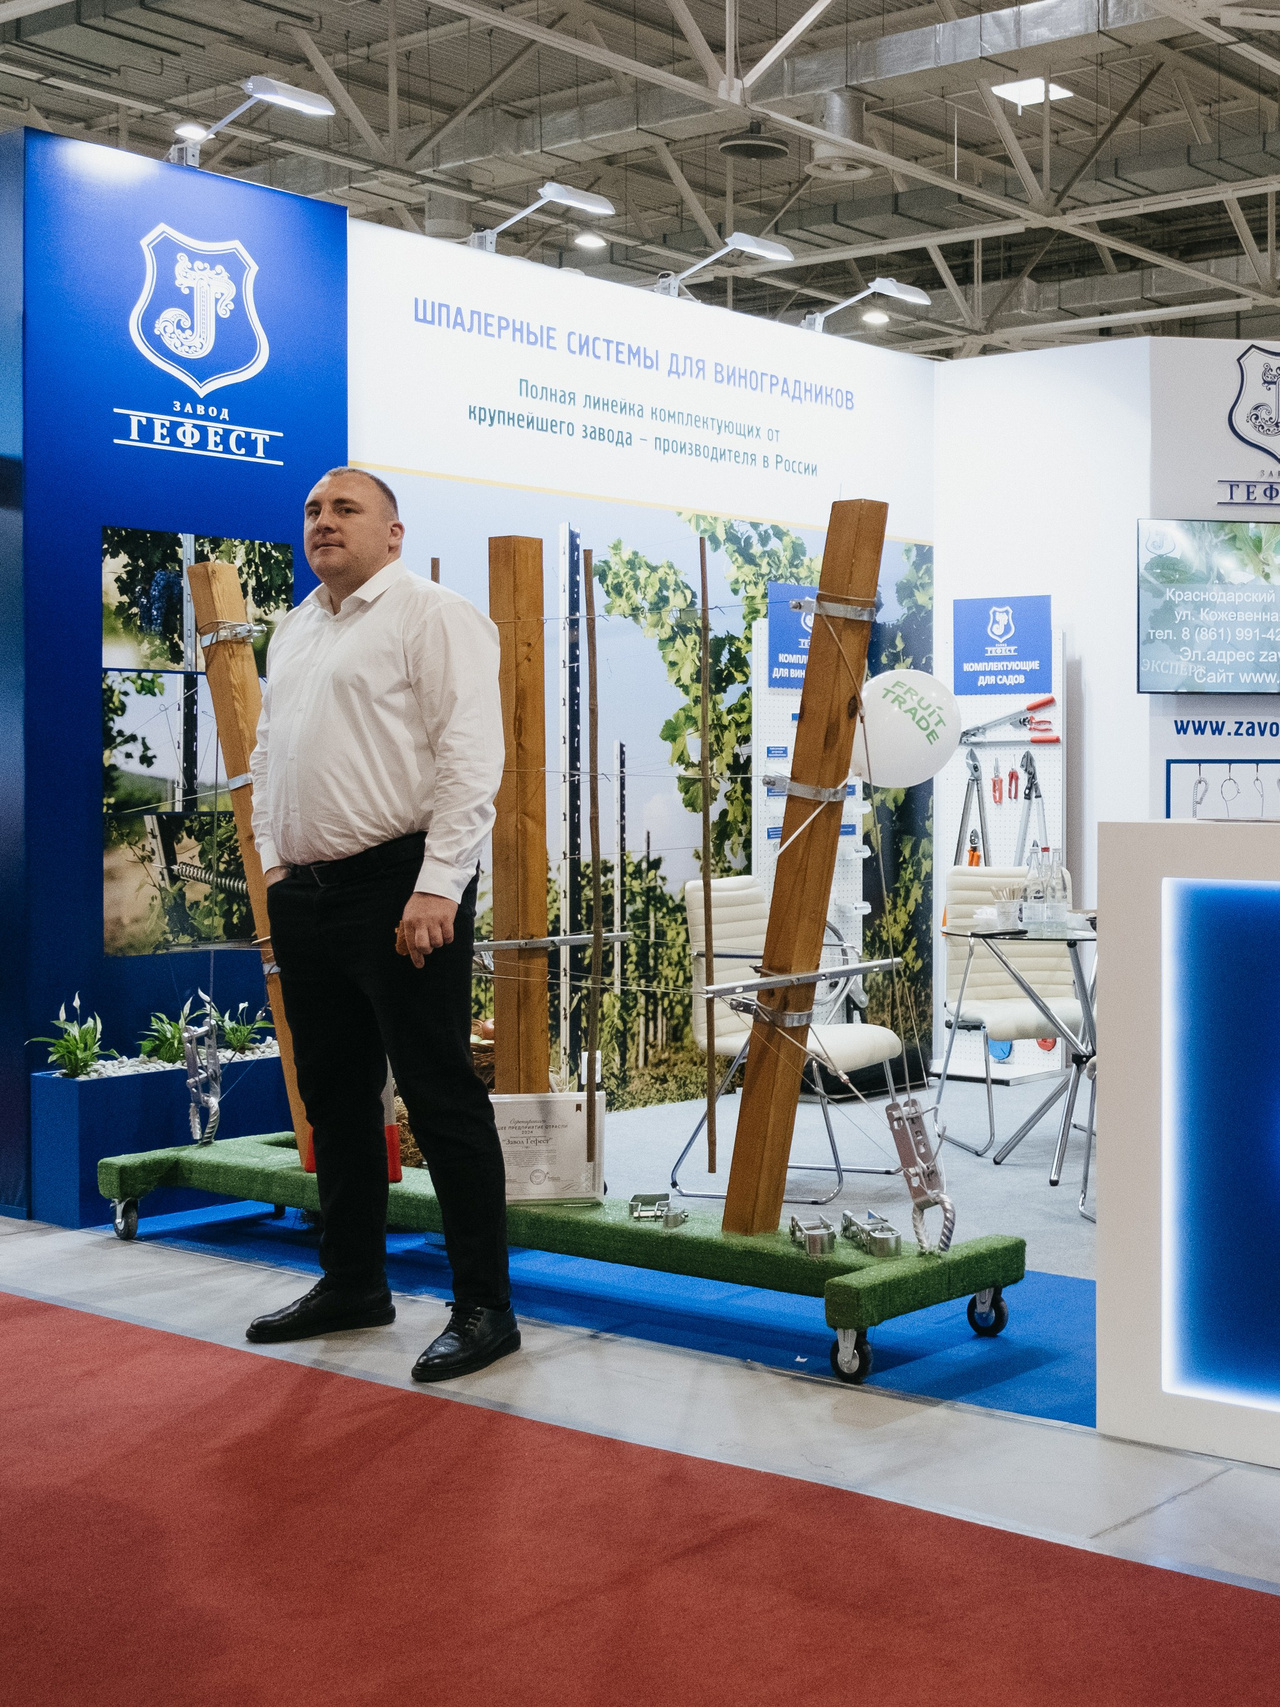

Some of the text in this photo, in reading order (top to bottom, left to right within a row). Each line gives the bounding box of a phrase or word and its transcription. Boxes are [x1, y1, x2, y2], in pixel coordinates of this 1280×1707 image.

[414, 297, 855, 411] ШПАЛЕРНЫЕ СИСТЕМЫ ДЛЯ ВИНОГРАДНИКОВ
[173, 401, 229, 421] ЗАВОД
[519, 378, 780, 442] Полная линейка комплектующих от
[129, 415, 270, 457] ГЕФЕСТ
[468, 405, 575, 437] крупнейшего
[582, 424, 633, 447] завода
[654, 436, 757, 463] производителя
[763, 455, 769, 468] в
[775, 454, 818, 477] России
[1166, 588, 1276, 605] Краснодарский
[1174, 610, 1195, 623] ул.
[1148, 629, 1177, 640] тел.
[1181, 627, 1191, 640] 8
[1194, 627, 1232, 643] (861)
[1180, 646, 1255, 665] Эл.адрес
[772, 667, 789, 679] ДЛЯ
[963, 660, 1040, 672] КОМПЛЕКТУЮЩИЕ
[1141, 658, 1207, 678] ЭКСПЕРТ
[977, 674, 1026, 686] ДЛЯ САДОВ
[1194, 668, 1234, 684] Сайт
[881, 687, 940, 746] TRADE
